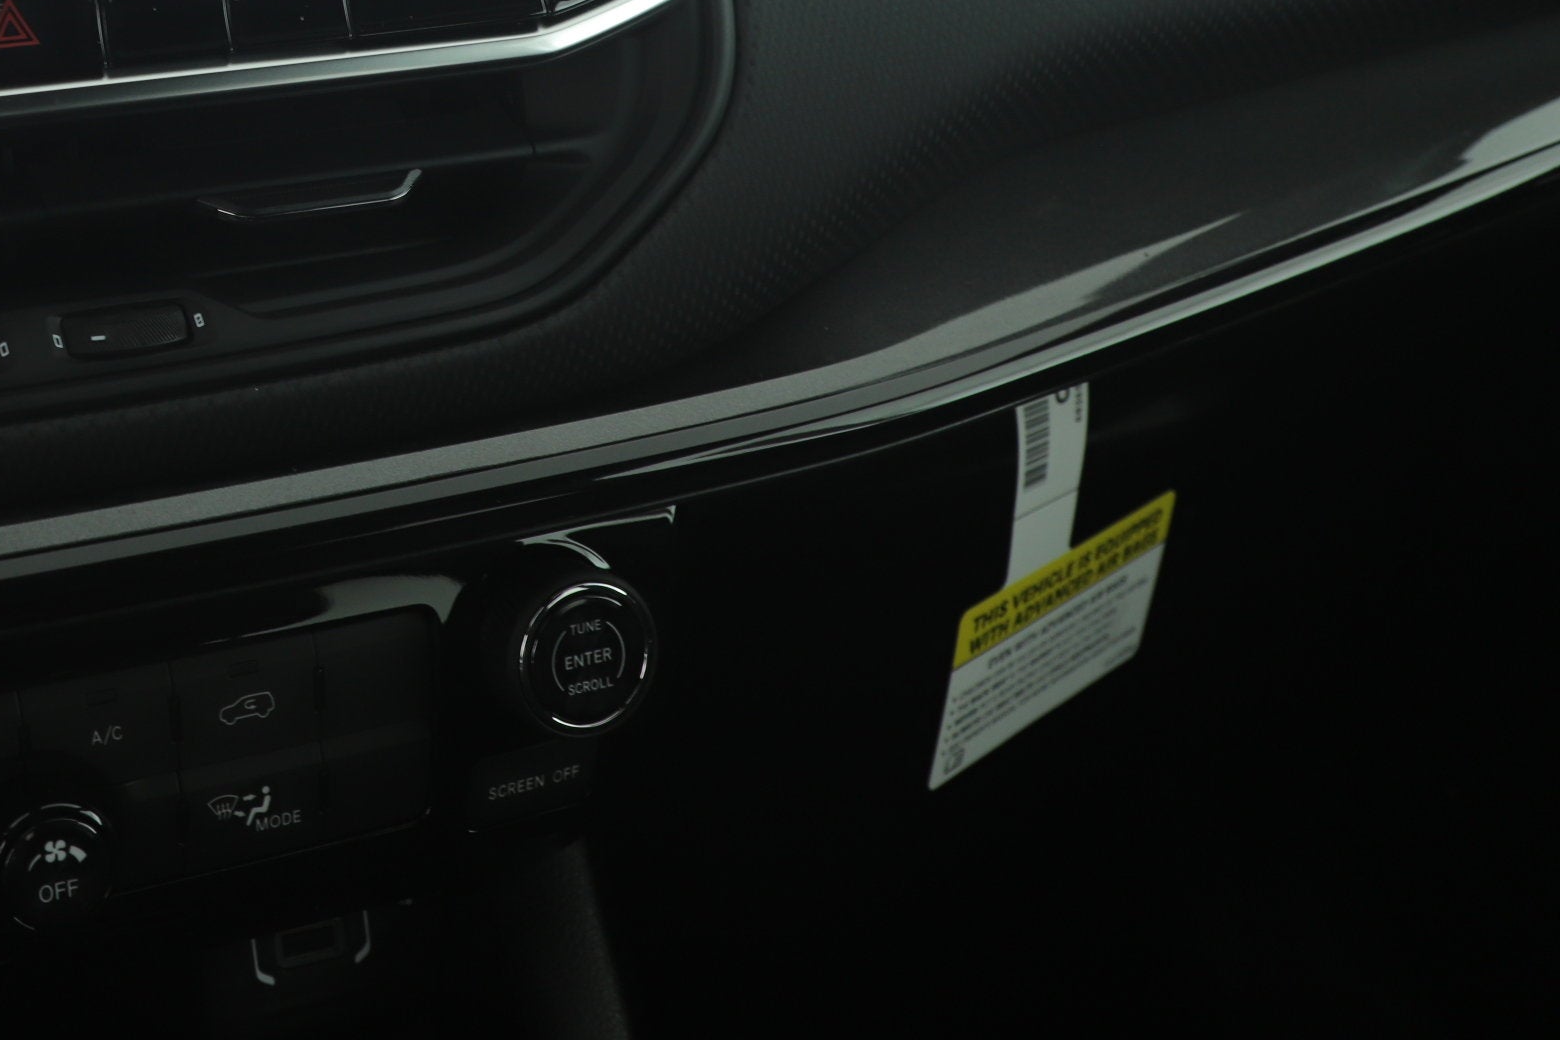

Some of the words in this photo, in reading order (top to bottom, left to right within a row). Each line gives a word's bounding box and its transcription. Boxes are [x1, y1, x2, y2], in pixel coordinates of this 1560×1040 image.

[569, 618, 603, 636] TUNE
[972, 601, 1009, 633] THIS
[969, 617, 1011, 654] WITH
[563, 646, 613, 671] ENTER
[567, 676, 615, 697] SCROLL
[90, 724, 124, 746] A/C
[487, 773, 546, 801] SCREEN
[551, 763, 582, 784] OFF
[255, 809, 303, 833] MODE
[38, 877, 80, 904] OFF
